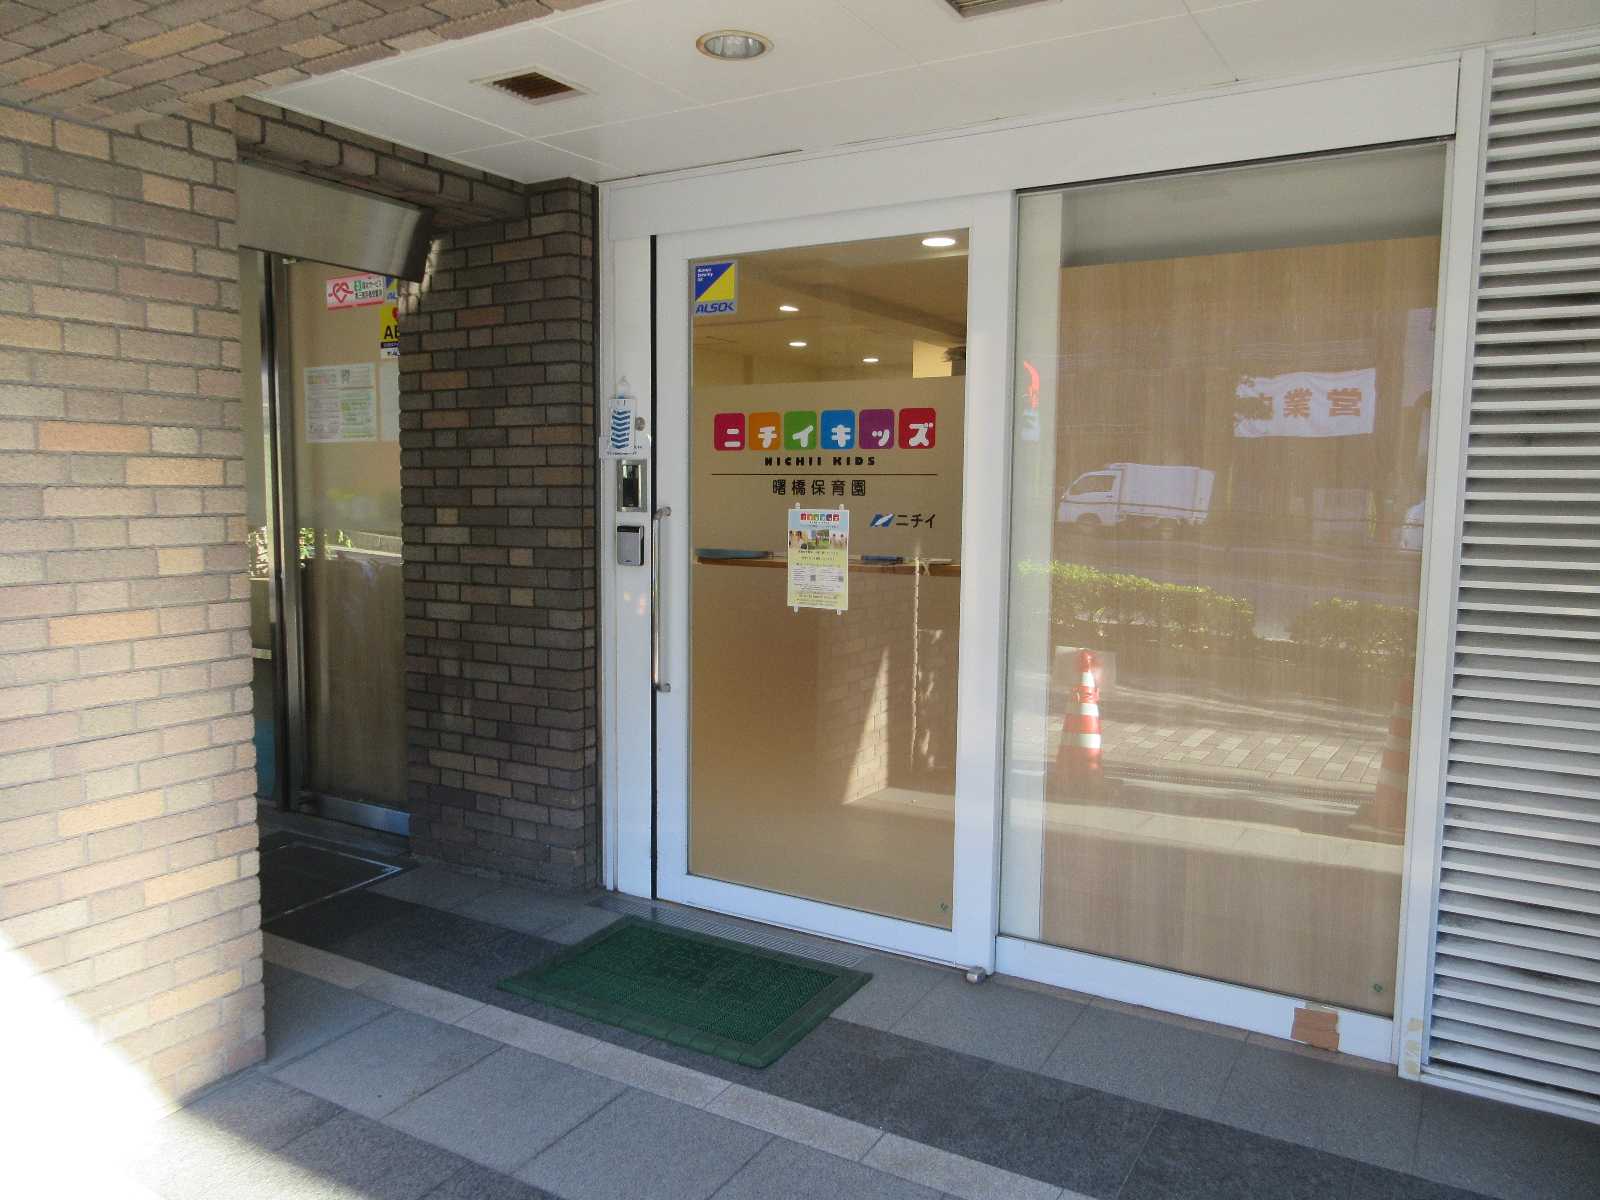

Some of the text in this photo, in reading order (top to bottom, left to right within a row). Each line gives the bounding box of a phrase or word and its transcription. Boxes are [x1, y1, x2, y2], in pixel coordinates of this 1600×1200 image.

[695, 302, 736, 314] ALSOK
[721, 419, 936, 449] ニチイキッズ
[765, 456, 876, 466] NICHII KIDS
[772, 479, 866, 496] 曙橋保育園
[895, 513, 936, 529] ニチイ
